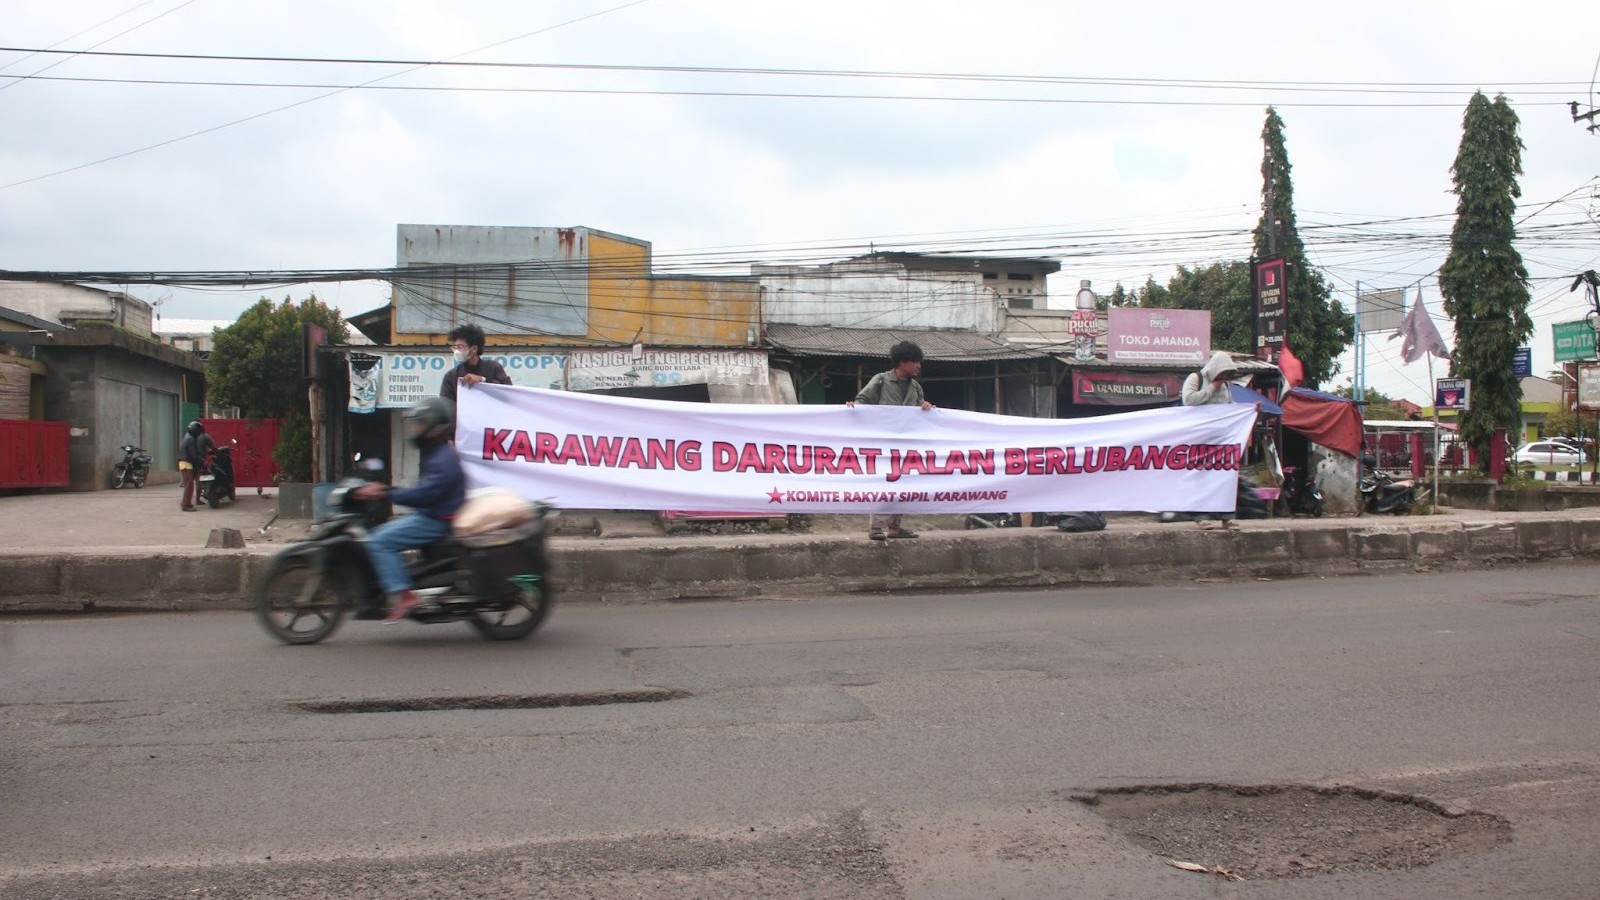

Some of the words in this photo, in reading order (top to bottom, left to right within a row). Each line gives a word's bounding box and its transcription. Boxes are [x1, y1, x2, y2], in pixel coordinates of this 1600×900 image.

[1120, 335, 1149, 345] TOKO
[1153, 337, 1200, 346] AMANDA
[391, 356, 445, 370] JOYO
[570, 351, 609, 368] NASI
[680, 352, 728, 366] PECEL
[389, 374, 420, 382] FOTOCOPY
[1136, 385, 1164, 395] SUPER
[482, 427, 702, 471] KARAWANG
[712, 441, 882, 474] DARURAT
[886, 448, 995, 482] JALAN
[786, 490, 840, 503] KOMITE
[843, 491, 897, 503] RAKYAT
[899, 491, 930, 502] SIPIL
[933, 490, 1008, 502] KARAWANG
